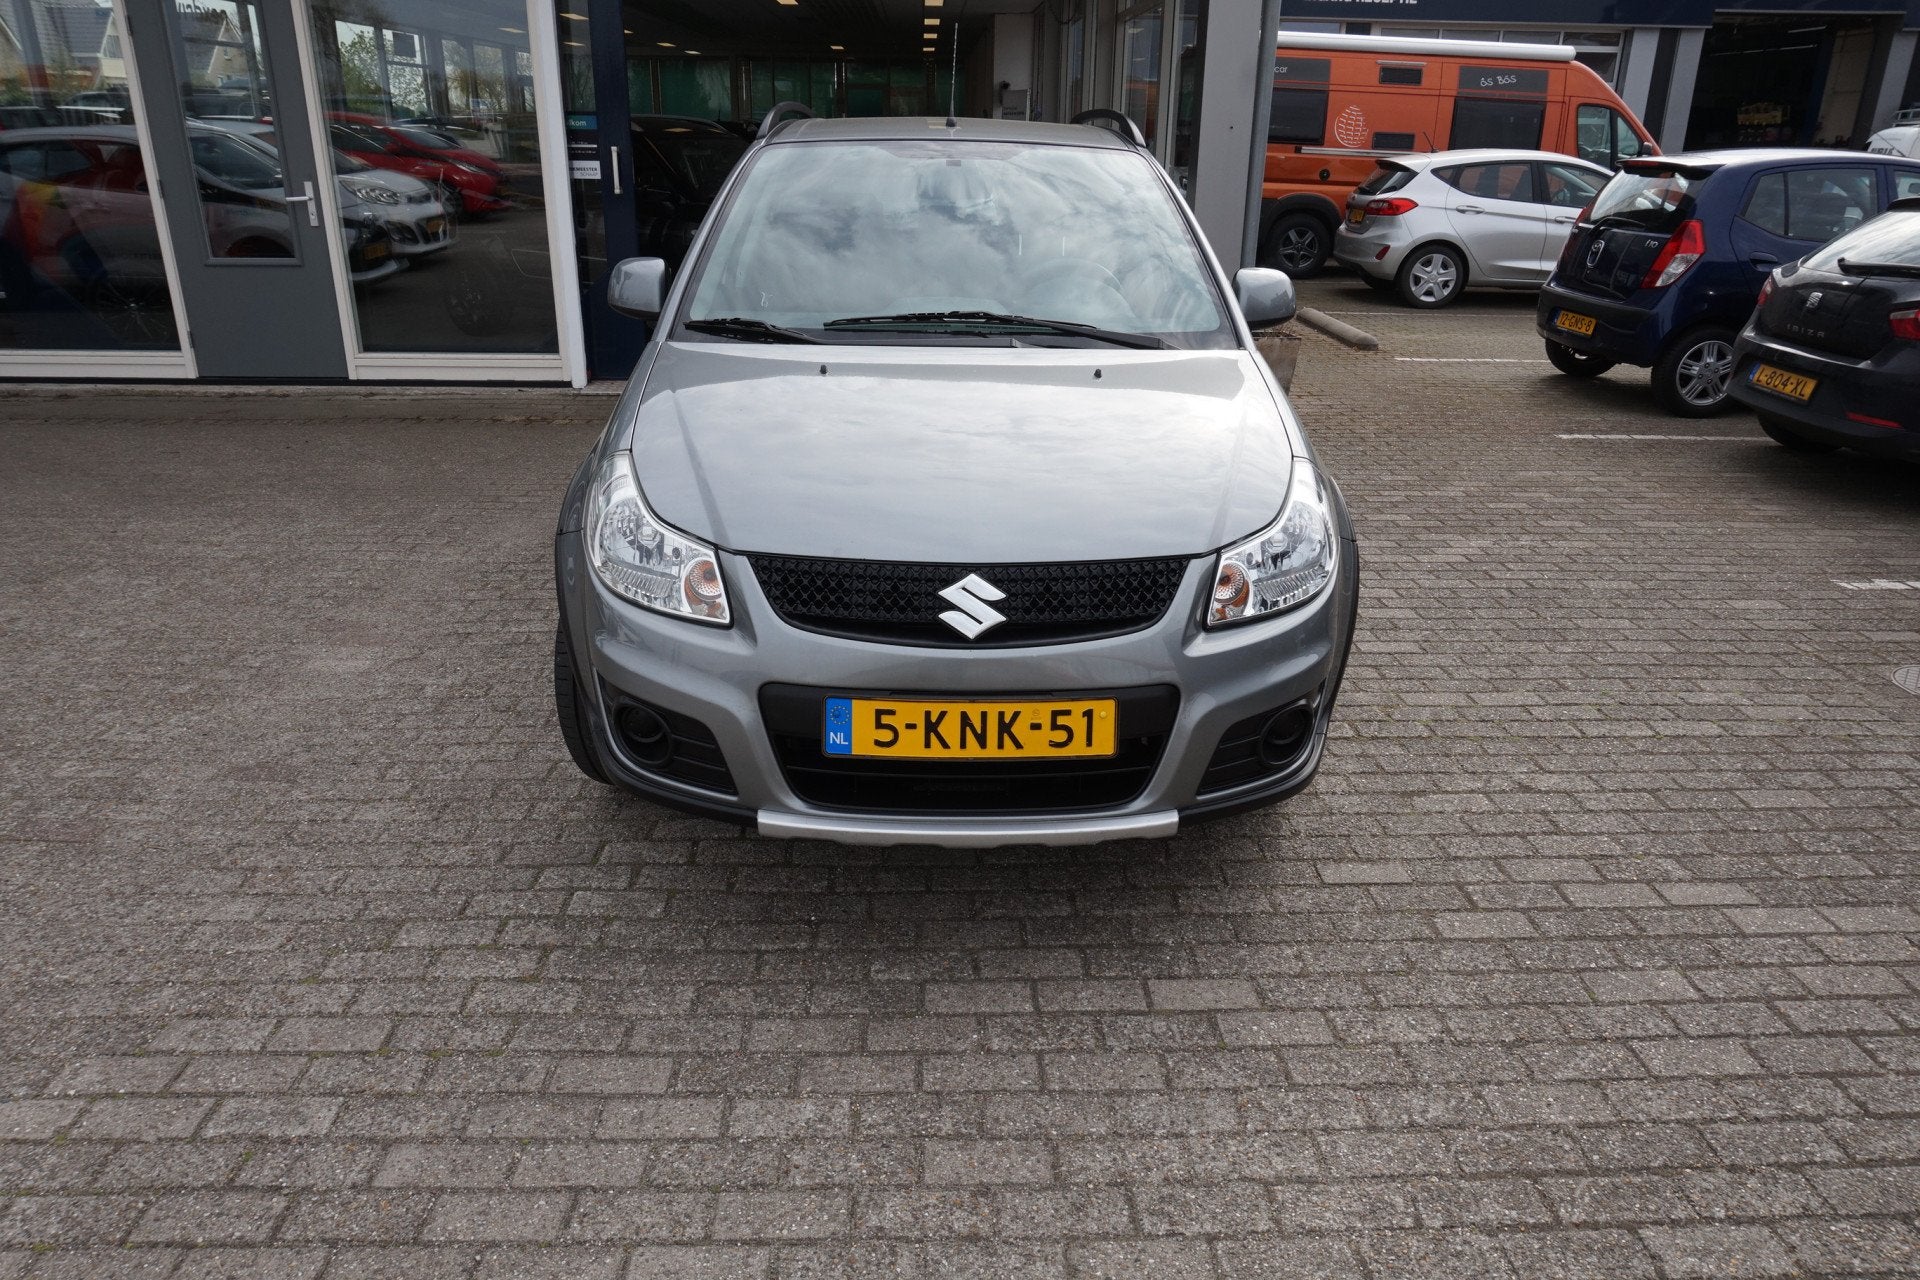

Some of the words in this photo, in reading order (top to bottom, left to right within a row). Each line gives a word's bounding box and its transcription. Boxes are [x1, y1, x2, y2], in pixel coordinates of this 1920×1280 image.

[1787, 323, 1825, 338] IBIZA
[1756, 367, 1808, 397] L-804-XL
[829, 732, 849, 746] NL
[873, 708, 1095, 750] 5-KNK-51
